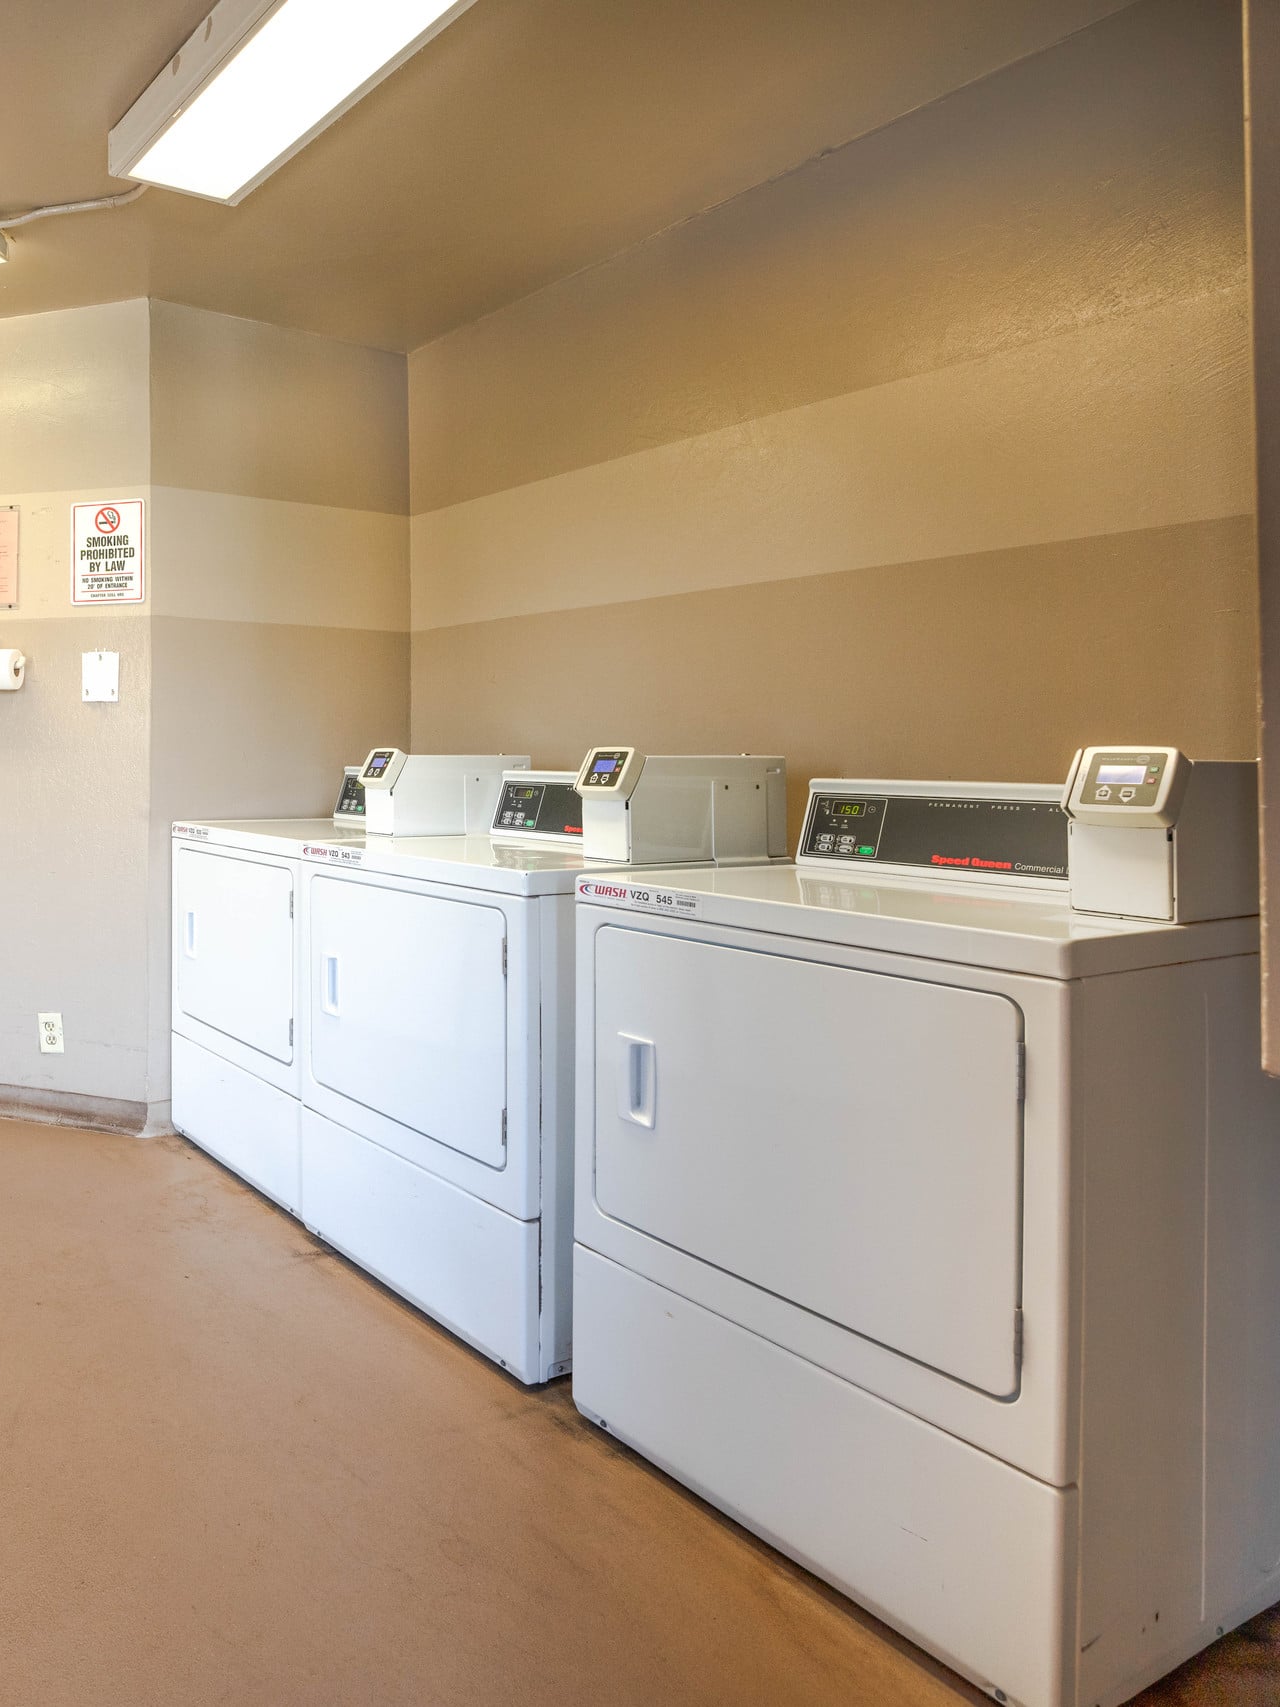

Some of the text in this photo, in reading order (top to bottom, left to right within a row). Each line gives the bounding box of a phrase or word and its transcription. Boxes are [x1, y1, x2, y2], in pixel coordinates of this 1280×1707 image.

[86, 535, 129, 548] SMOKING
[80, 547, 135, 560] PROHIBITED
[89, 560, 125, 572] BY LAW
[564, 825, 583, 833] Spee
[311, 848, 327, 856] WASH
[931, 854, 970, 866] Speed
[971, 857, 1012, 870] Queen
[1015, 862, 1064, 874] Commercial
[595, 885, 673, 905] WASH VZQ 545
